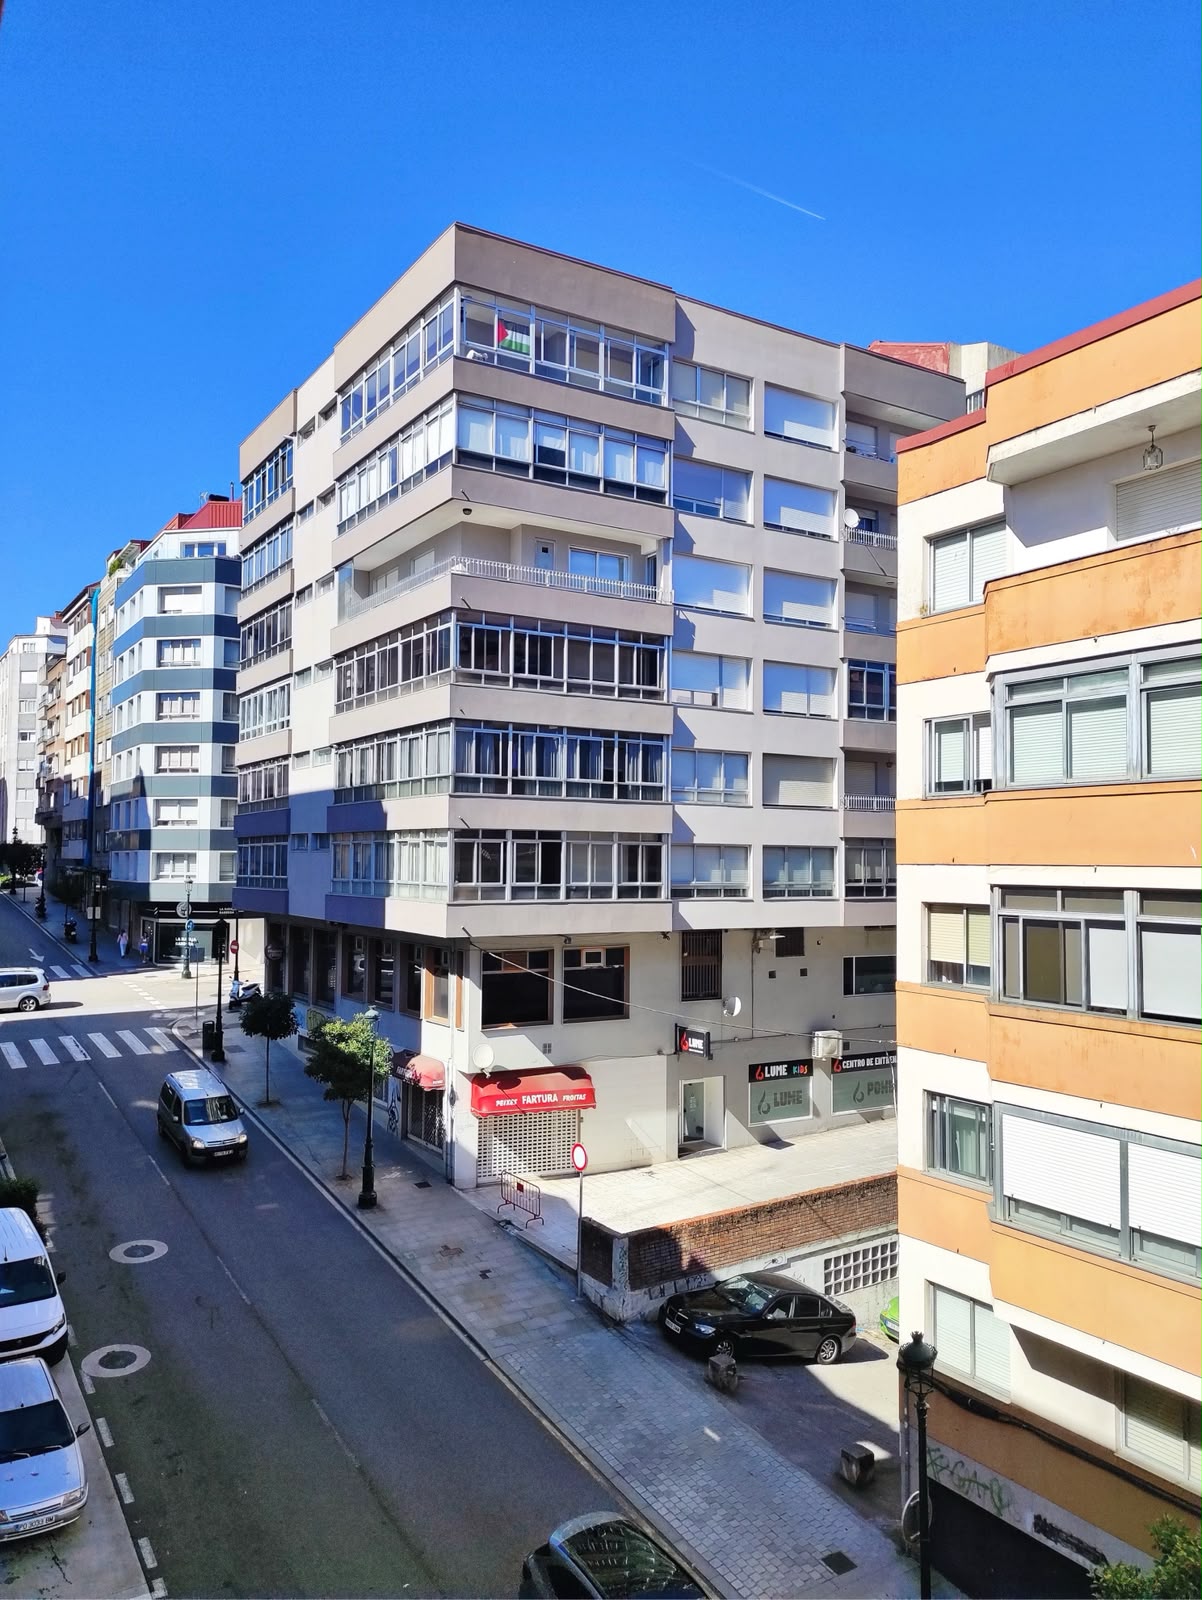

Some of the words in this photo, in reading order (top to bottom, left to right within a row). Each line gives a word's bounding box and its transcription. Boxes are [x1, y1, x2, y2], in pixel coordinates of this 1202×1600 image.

[688, 1038, 703, 1049] LUME
[842, 1059, 865, 1069] CENTRO
[866, 1058, 874, 1066] DE
[764, 1065, 788, 1077] LUME
[522, 1093, 558, 1104] FARTURA
[562, 1094, 586, 1102] FROITAS
[773, 1090, 802, 1107] LUME
